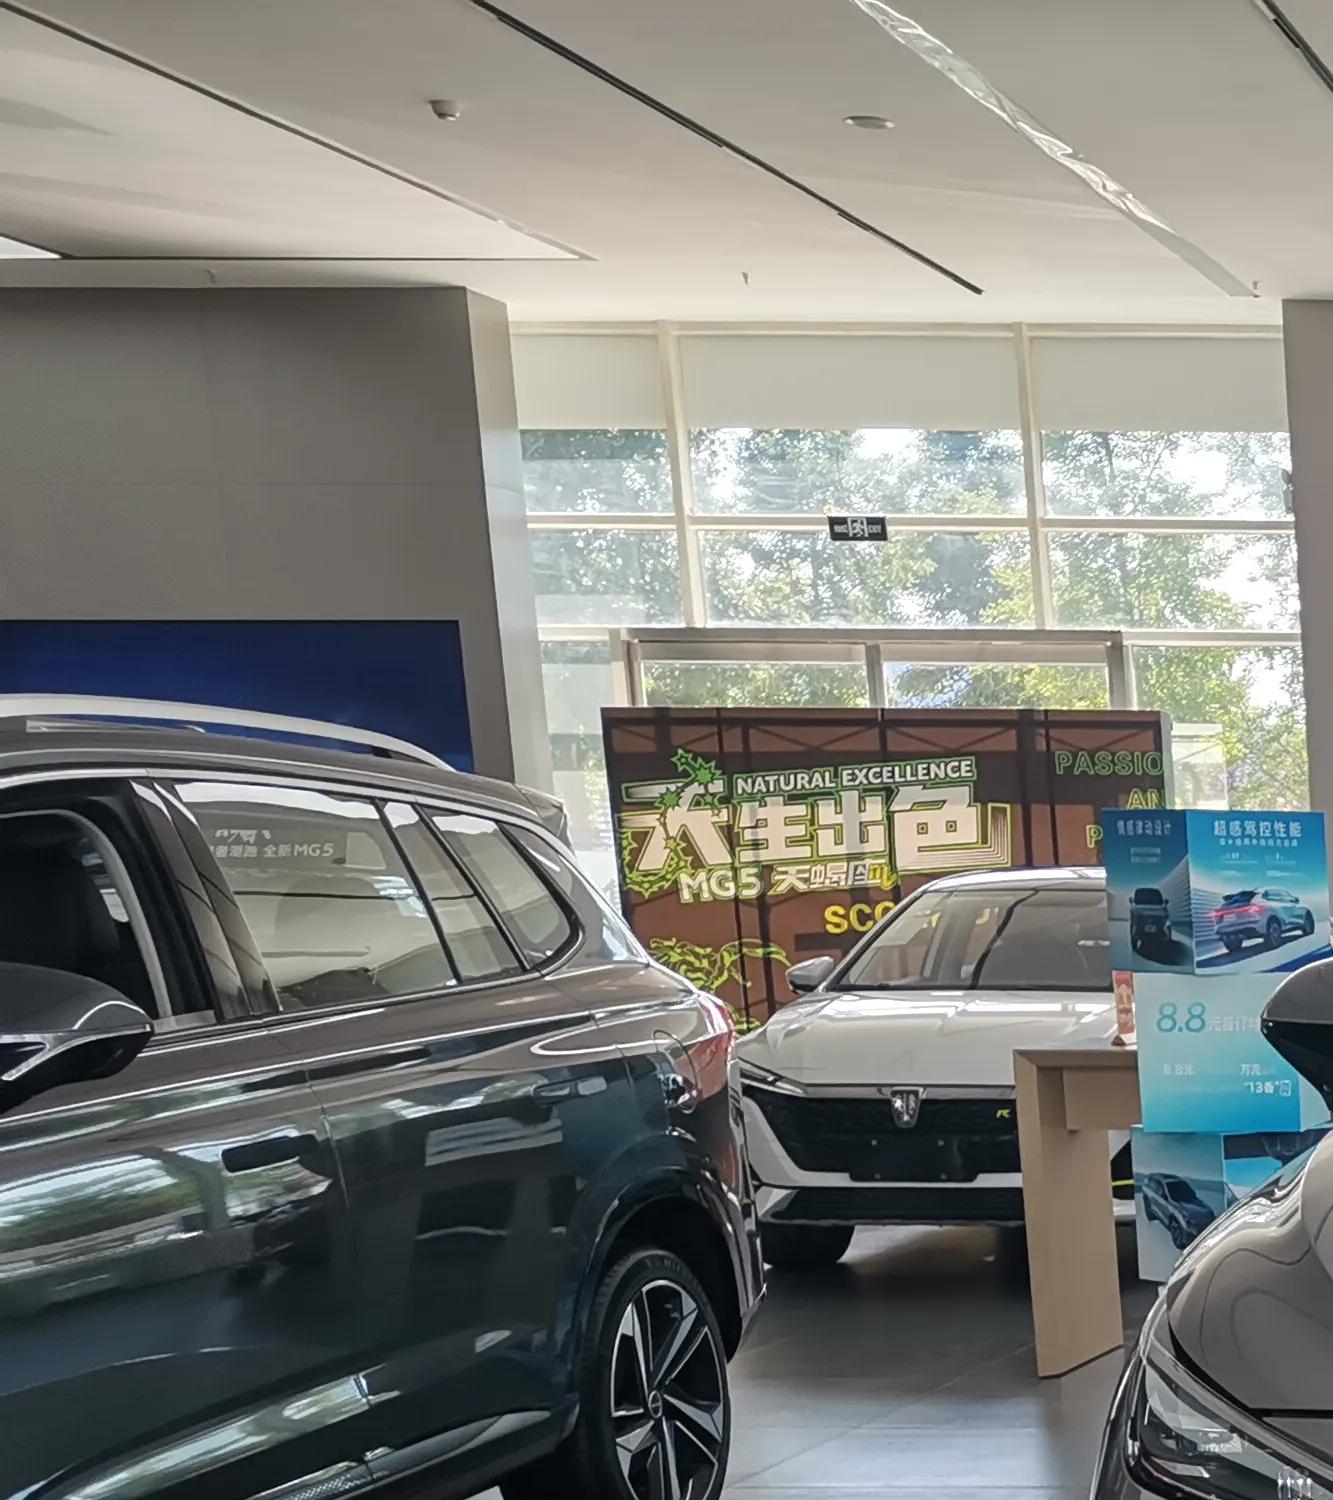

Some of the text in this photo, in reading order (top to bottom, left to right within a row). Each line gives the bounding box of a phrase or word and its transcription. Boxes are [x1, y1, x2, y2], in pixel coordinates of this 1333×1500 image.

[736, 759, 974, 795] NATURAL EXCELLENCE
[679, 866, 764, 903] MG5
